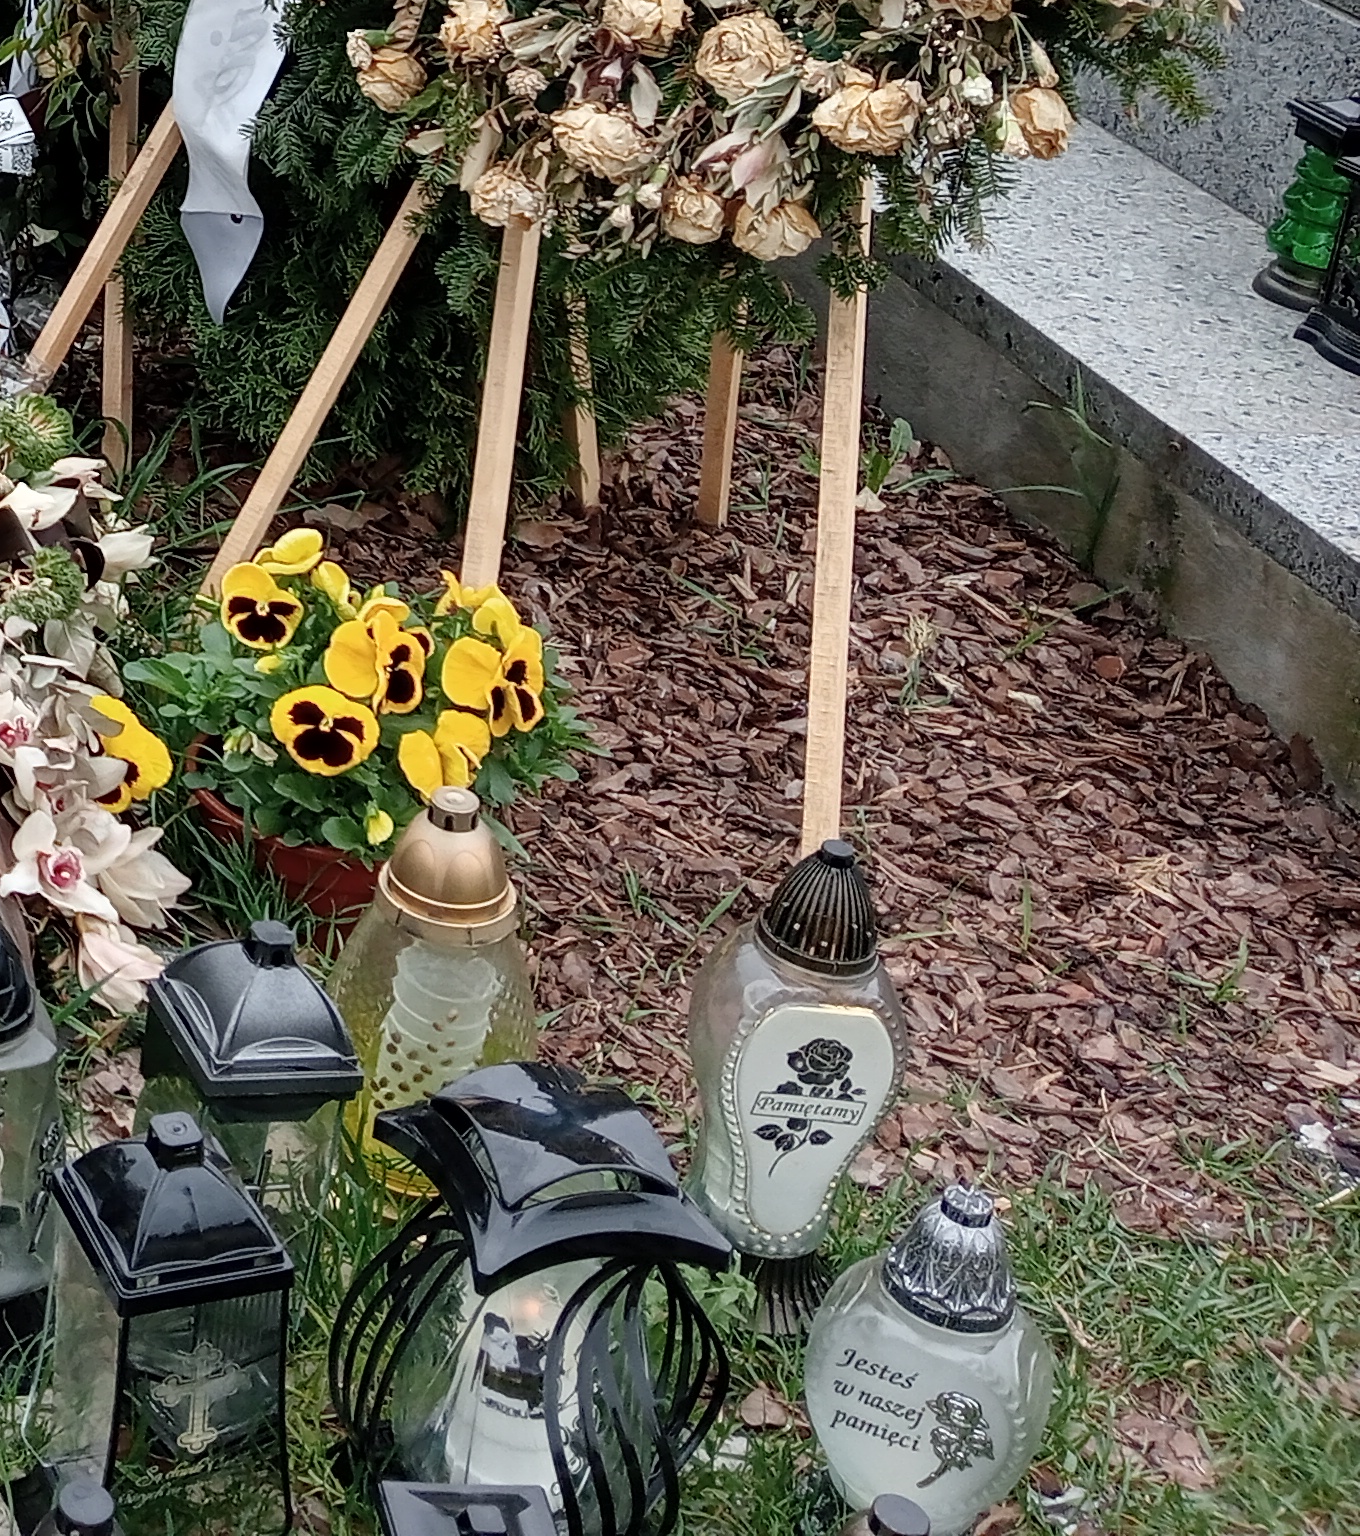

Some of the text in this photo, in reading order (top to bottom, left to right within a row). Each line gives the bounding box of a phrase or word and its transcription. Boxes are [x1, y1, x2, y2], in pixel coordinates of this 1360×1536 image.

[757, 1096, 861, 1123] Pamiętamy
[835, 1348, 919, 1390] Jesteś
[833, 1378, 927, 1430] w naszej
[830, 1408, 922, 1452] pamięci
